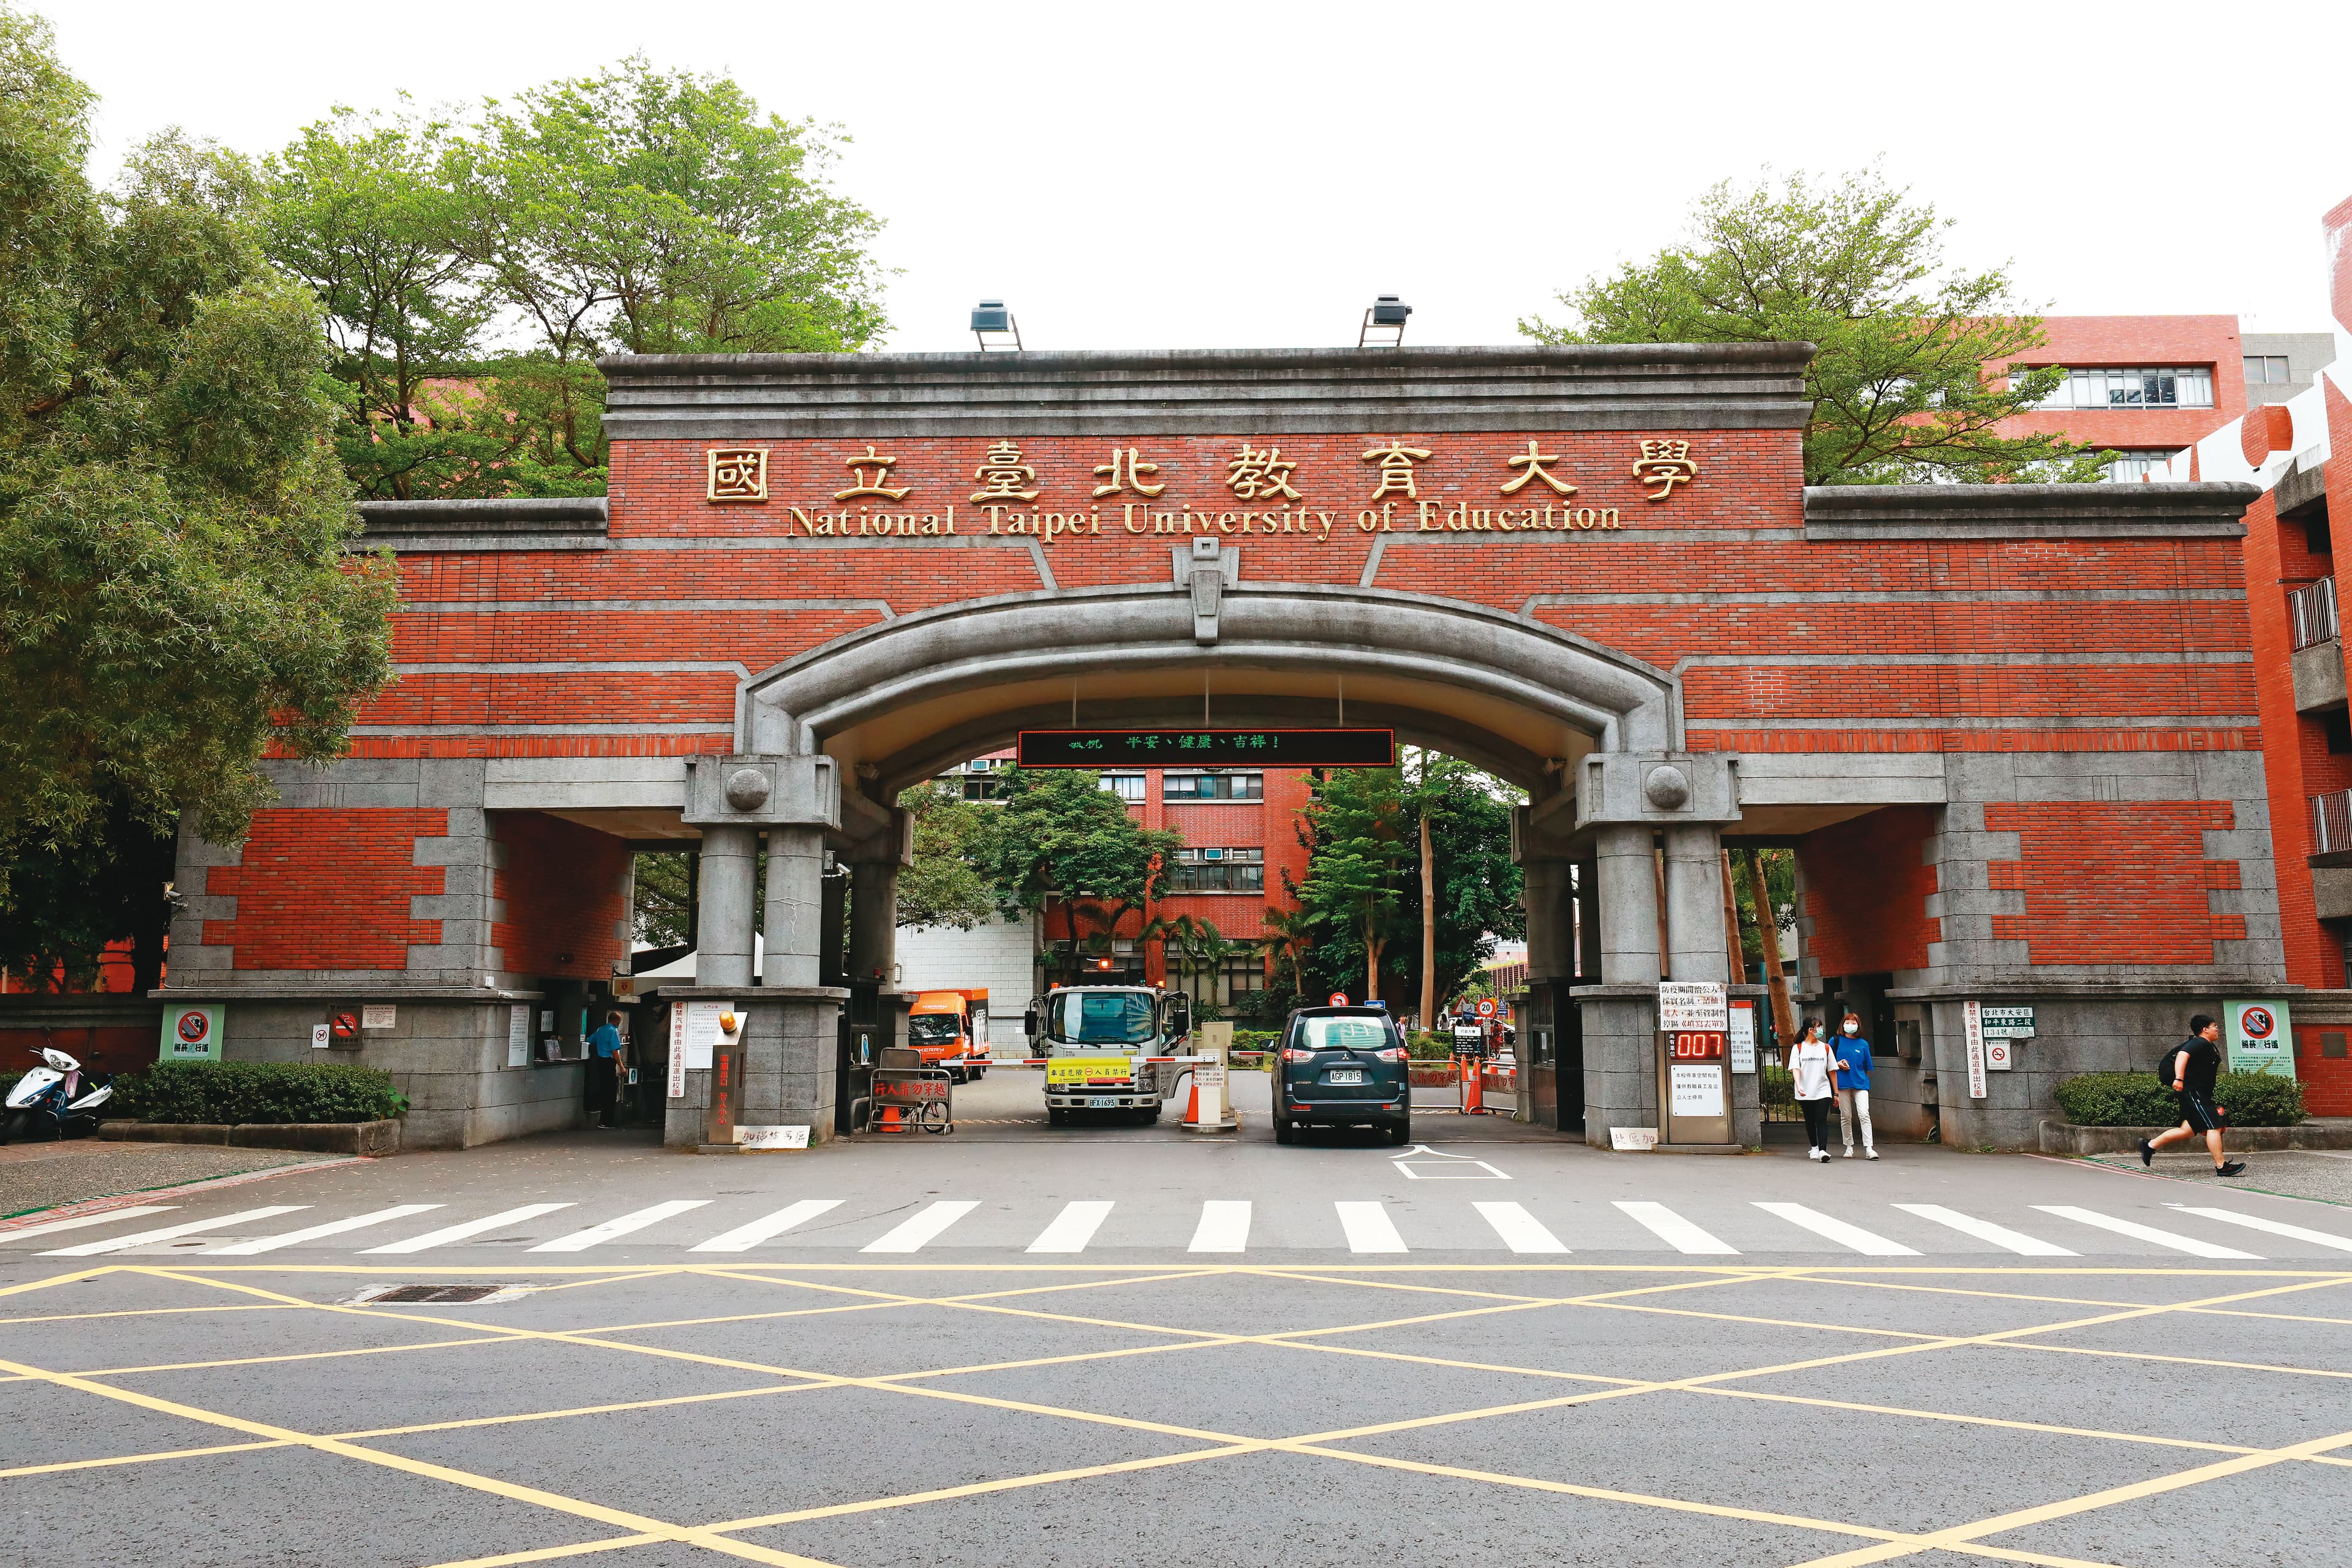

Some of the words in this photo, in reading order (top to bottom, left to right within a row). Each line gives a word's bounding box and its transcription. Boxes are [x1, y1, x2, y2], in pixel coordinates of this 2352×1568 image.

[707, 440, 1697, 502] 國立臺北教育大學
[787, 505, 957, 537] National
[981, 505, 1100, 543] Taipei
[1123, 502, 1338, 542] University
[1357, 502, 1397, 532] of
[1415, 499, 1623, 532] Education
[672, 1002, 684, 1096] 嚴禁汽機車由此通道進出校園
[1678, 1034, 1721, 1056] 007
[1968, 1001, 1982, 1097] 嚴禁汽機車由此通道進出校園
[875, 1082, 946, 1096] 行人請勿穿越
